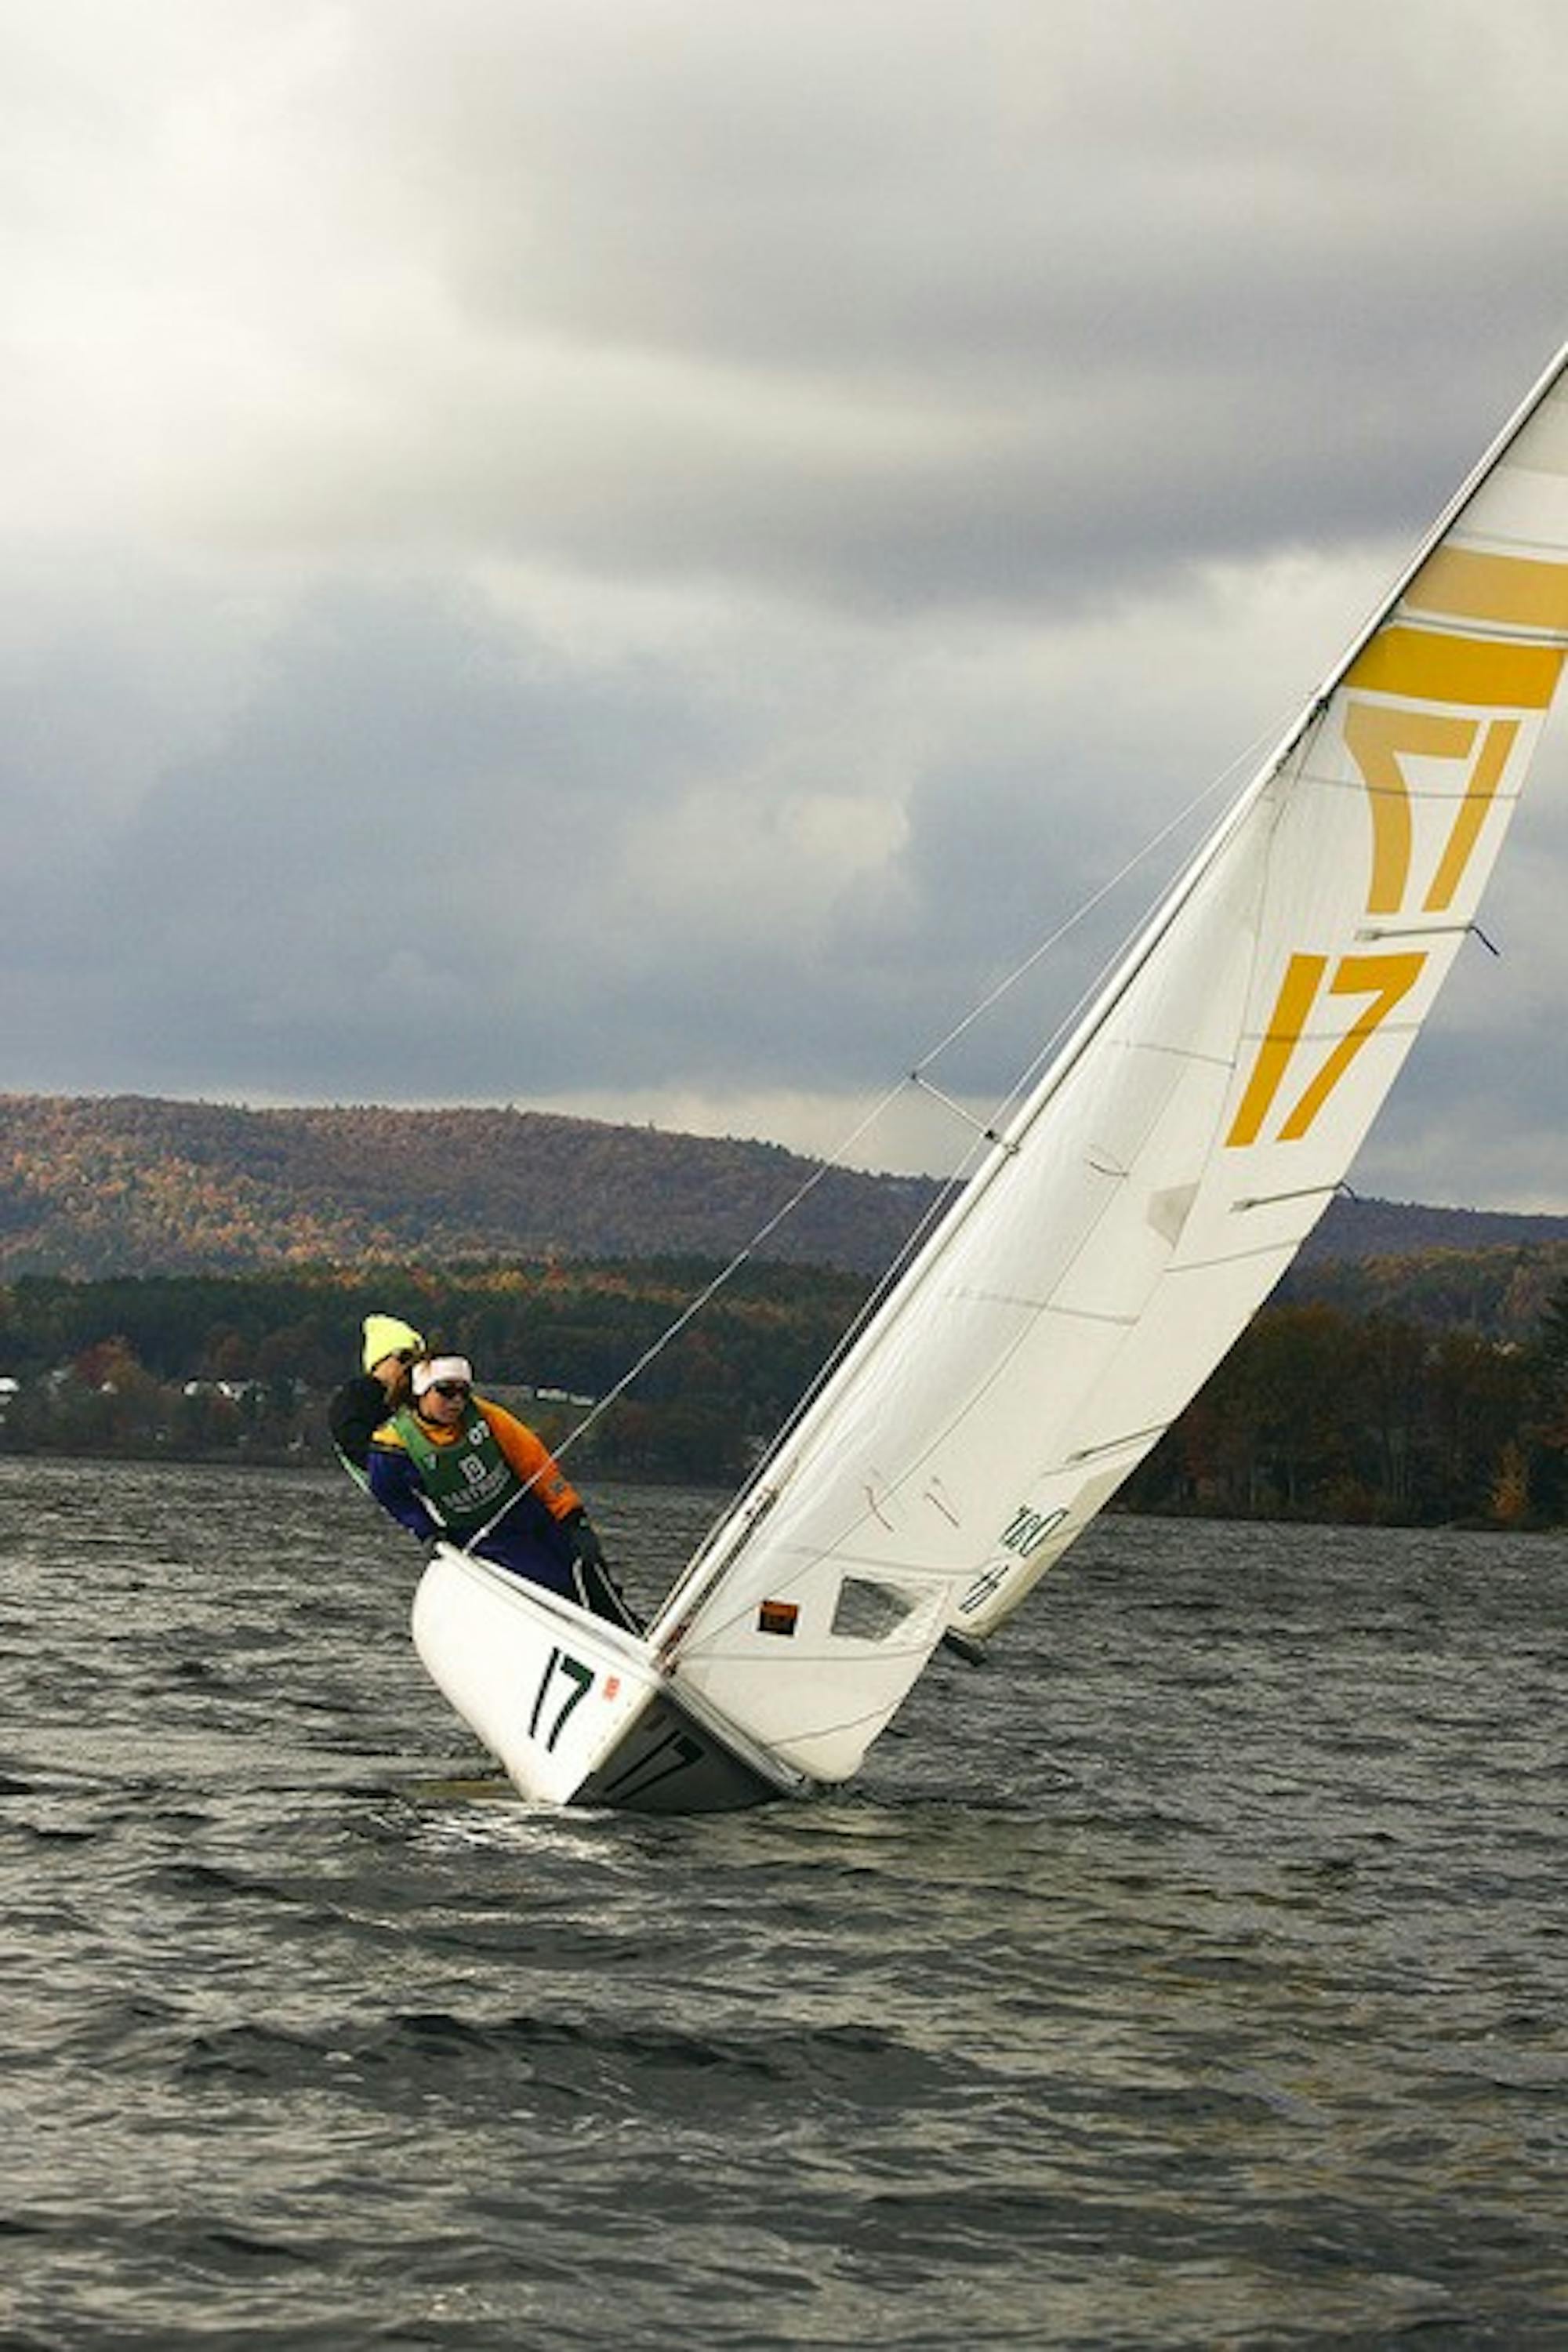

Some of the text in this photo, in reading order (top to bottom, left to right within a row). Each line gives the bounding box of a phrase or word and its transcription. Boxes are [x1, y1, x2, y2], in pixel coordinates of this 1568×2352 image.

[1224, 951, 1429, 1147] 17
[528, 1647, 595, 1753] 17
[604, 1730, 706, 1800] 17
